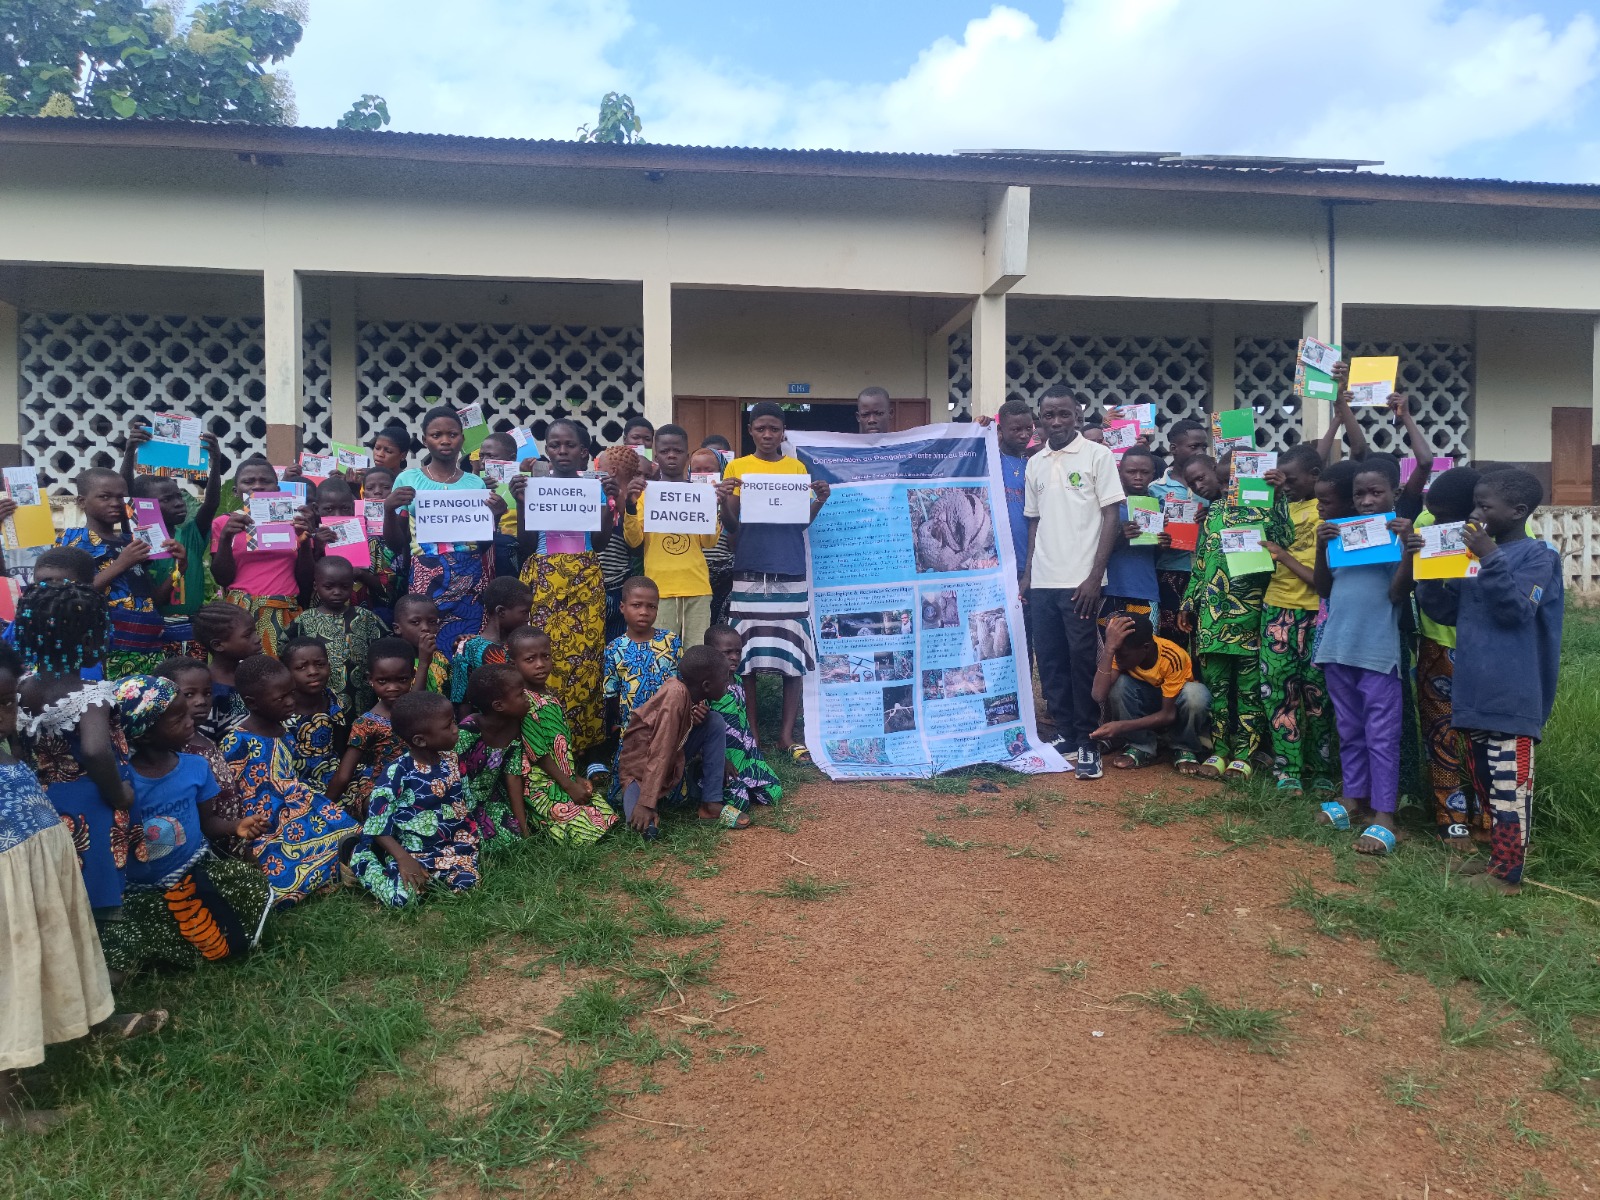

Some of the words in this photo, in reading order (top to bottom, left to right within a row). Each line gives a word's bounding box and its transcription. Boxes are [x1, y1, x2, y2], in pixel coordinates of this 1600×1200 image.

[743, 482, 809, 491] PROTEGEONS
[538, 487, 586, 498] DANGER,
[660, 491, 682, 502] EST
[684, 492, 701, 503] EN
[418, 499, 431, 508] LE
[769, 497, 783, 506] LE.
[528, 503, 558, 512] C'EST
[560, 503, 577, 512] LUI
[579, 504, 597, 513] QUI
[451, 515, 471, 523] PAS
[473, 514, 489, 522] UN
[650, 510, 709, 522] DANGER.
